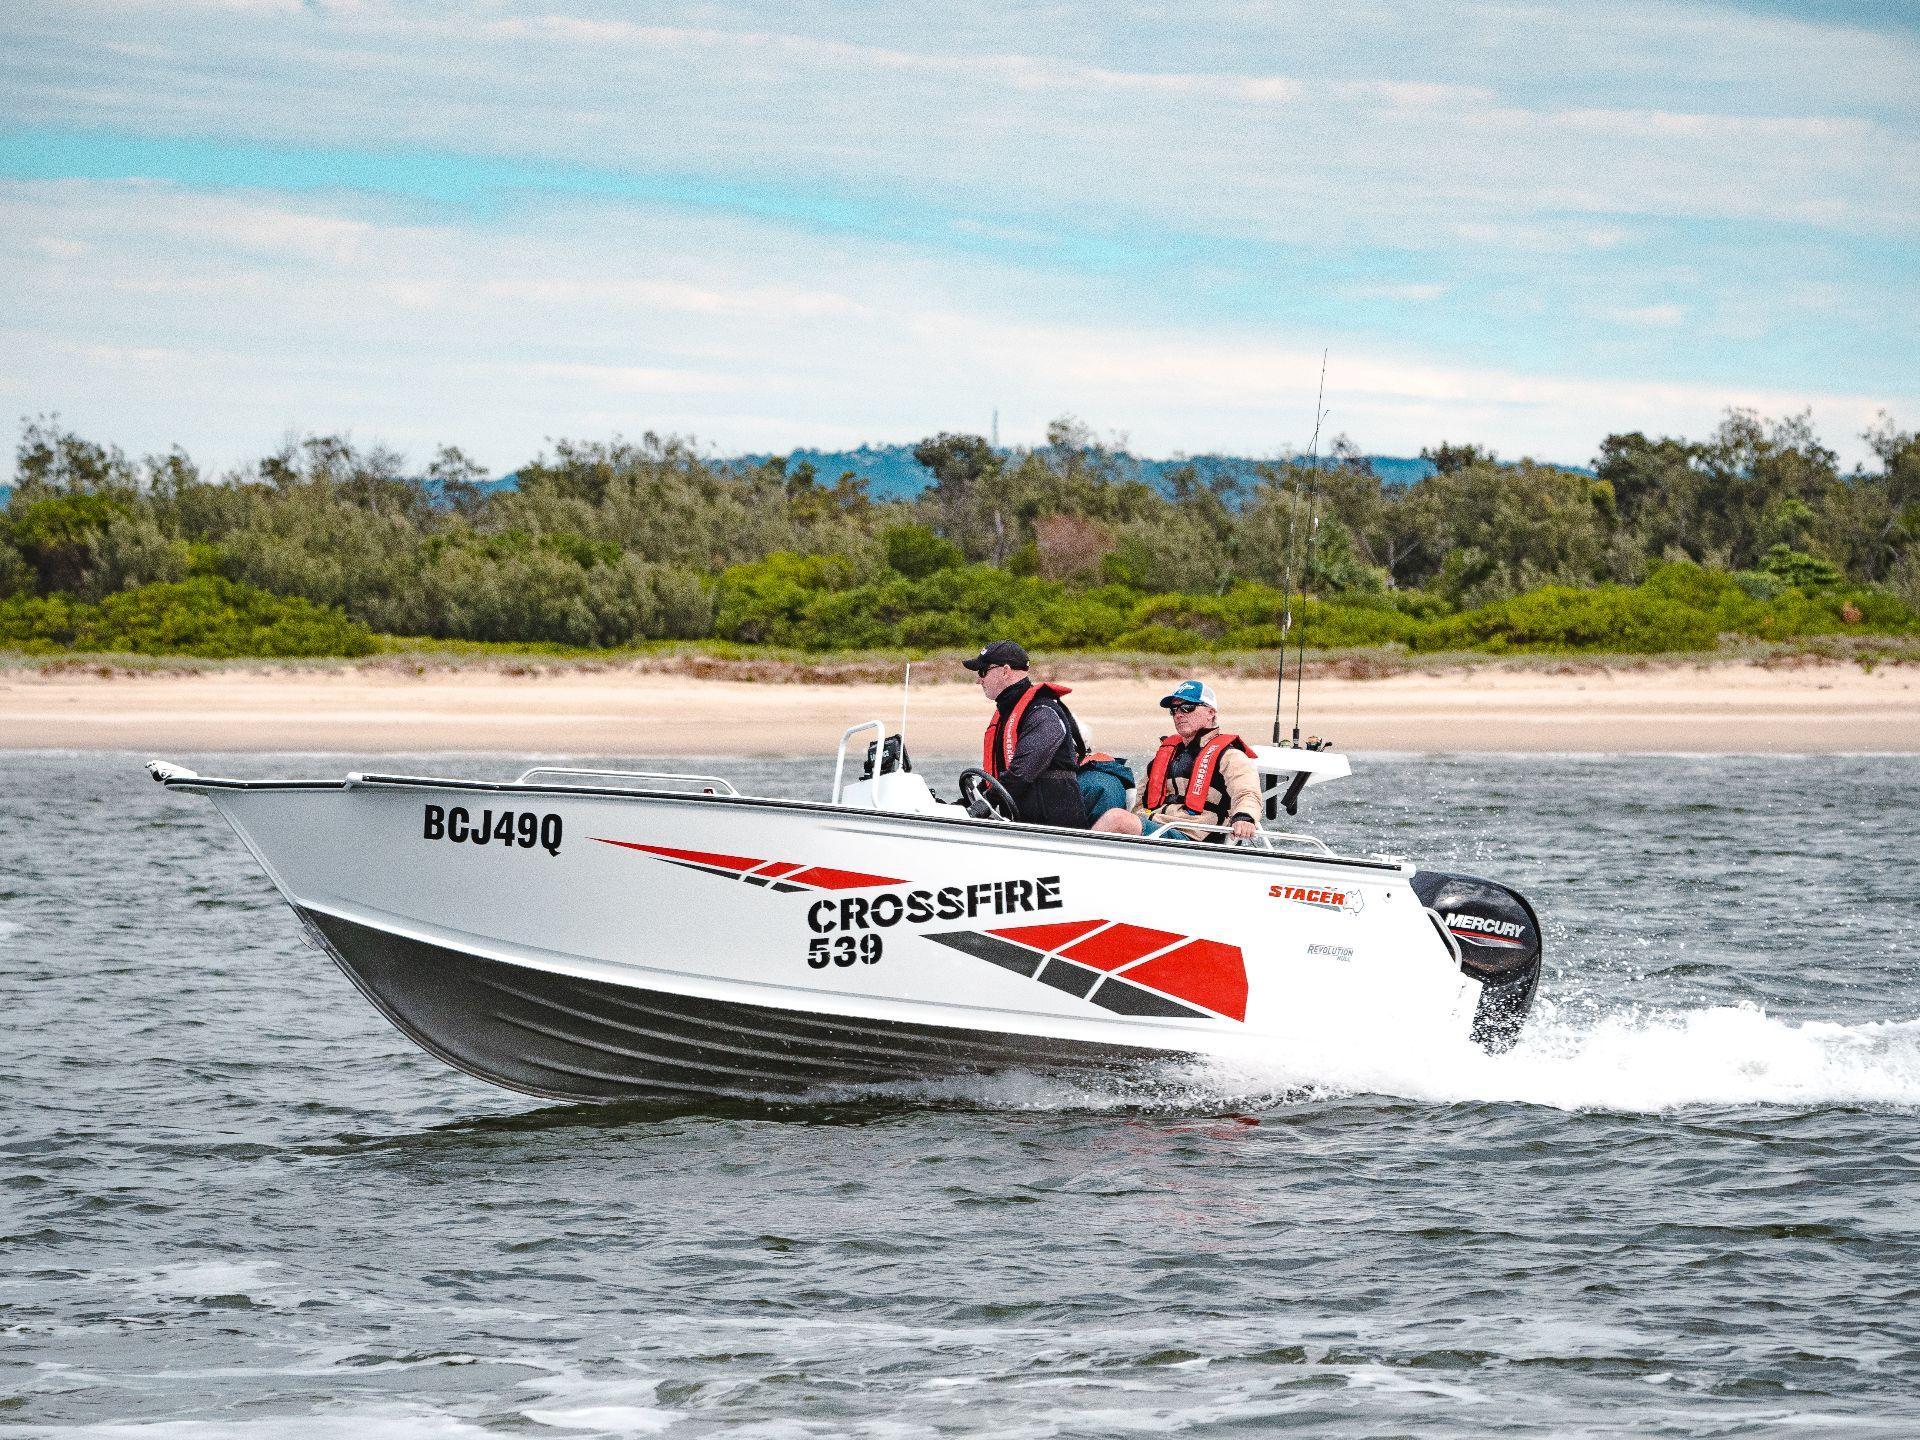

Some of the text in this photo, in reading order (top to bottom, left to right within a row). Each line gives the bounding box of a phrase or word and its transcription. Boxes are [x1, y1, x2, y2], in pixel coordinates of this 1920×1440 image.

[424, 804, 563, 857] BCJ49Q
[807, 875, 1063, 934] CROSSFIRE
[1269, 885, 1345, 905] STACER
[1444, 912, 1526, 938] MERCURY
[807, 933, 884, 969] 539
[1307, 944, 1354, 956] REVOLUTION
